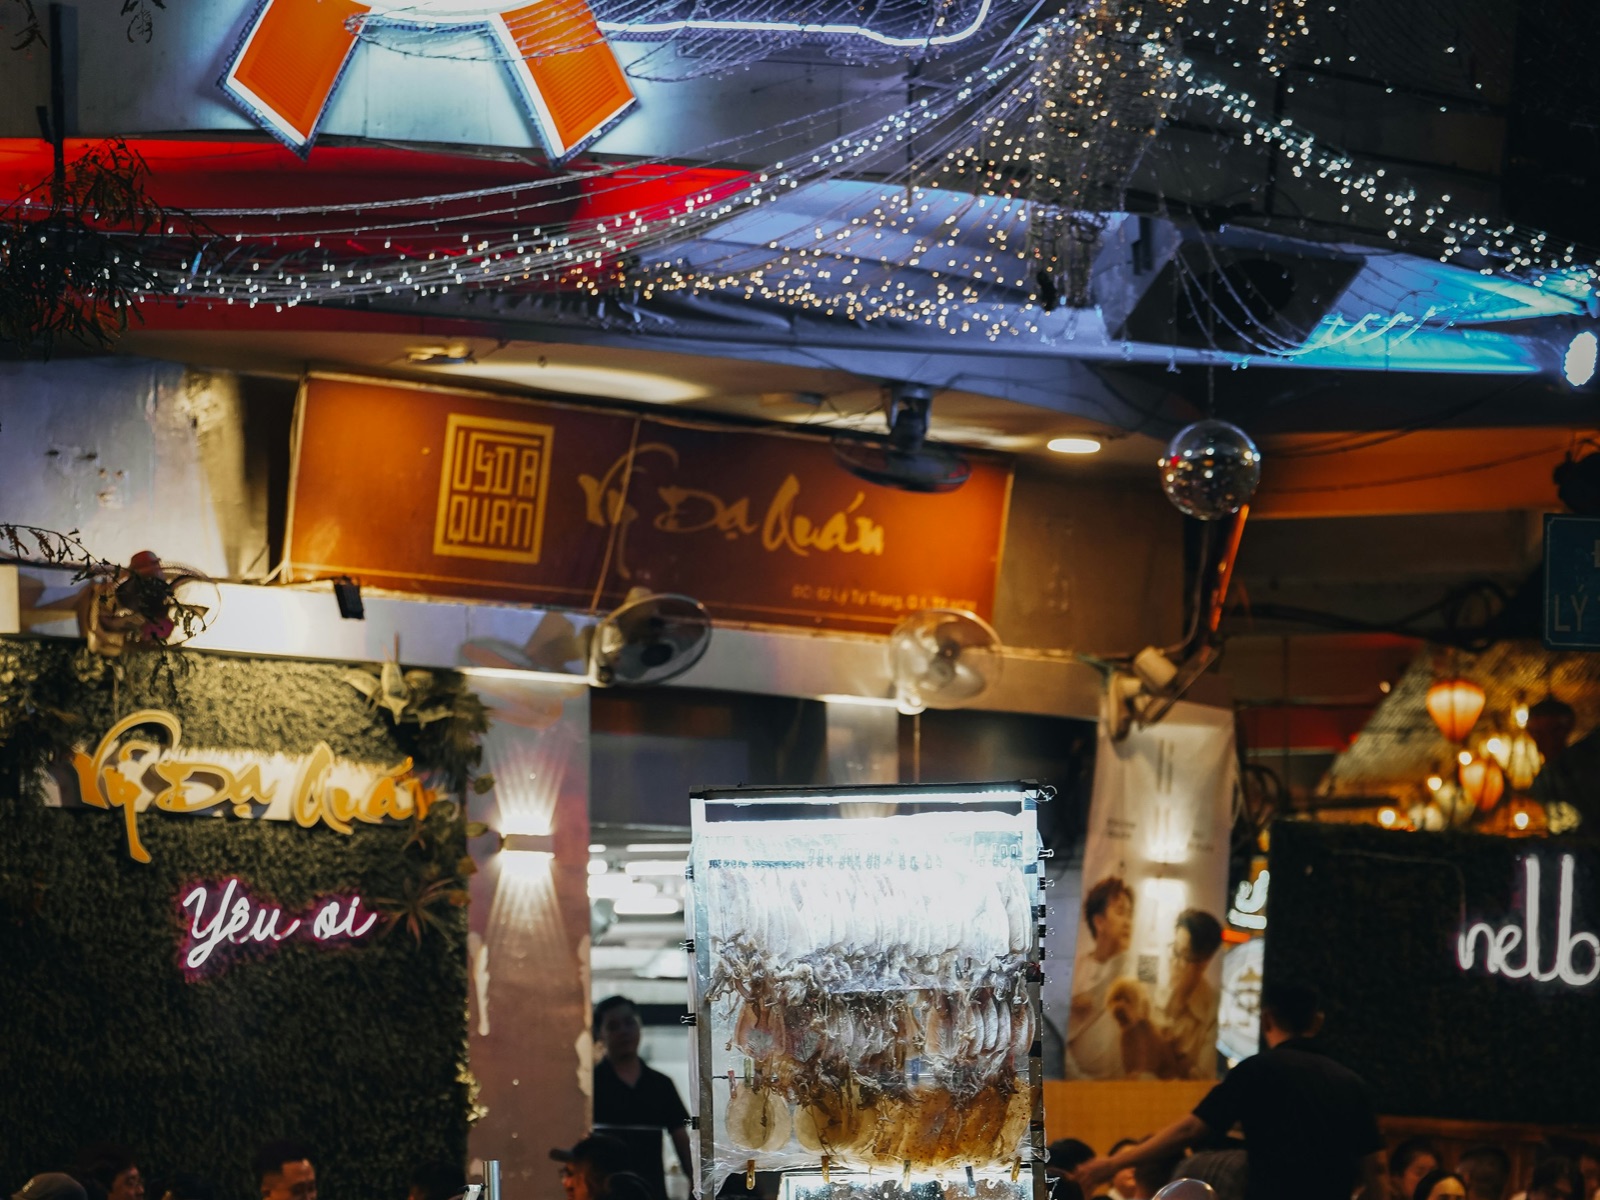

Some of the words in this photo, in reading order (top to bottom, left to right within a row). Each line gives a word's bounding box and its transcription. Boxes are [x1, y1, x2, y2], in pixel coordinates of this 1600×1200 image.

[762, 473, 885, 556] Quán
[1554, 584, 1589, 632] LÝ
[182, 879, 301, 968] Yêu
